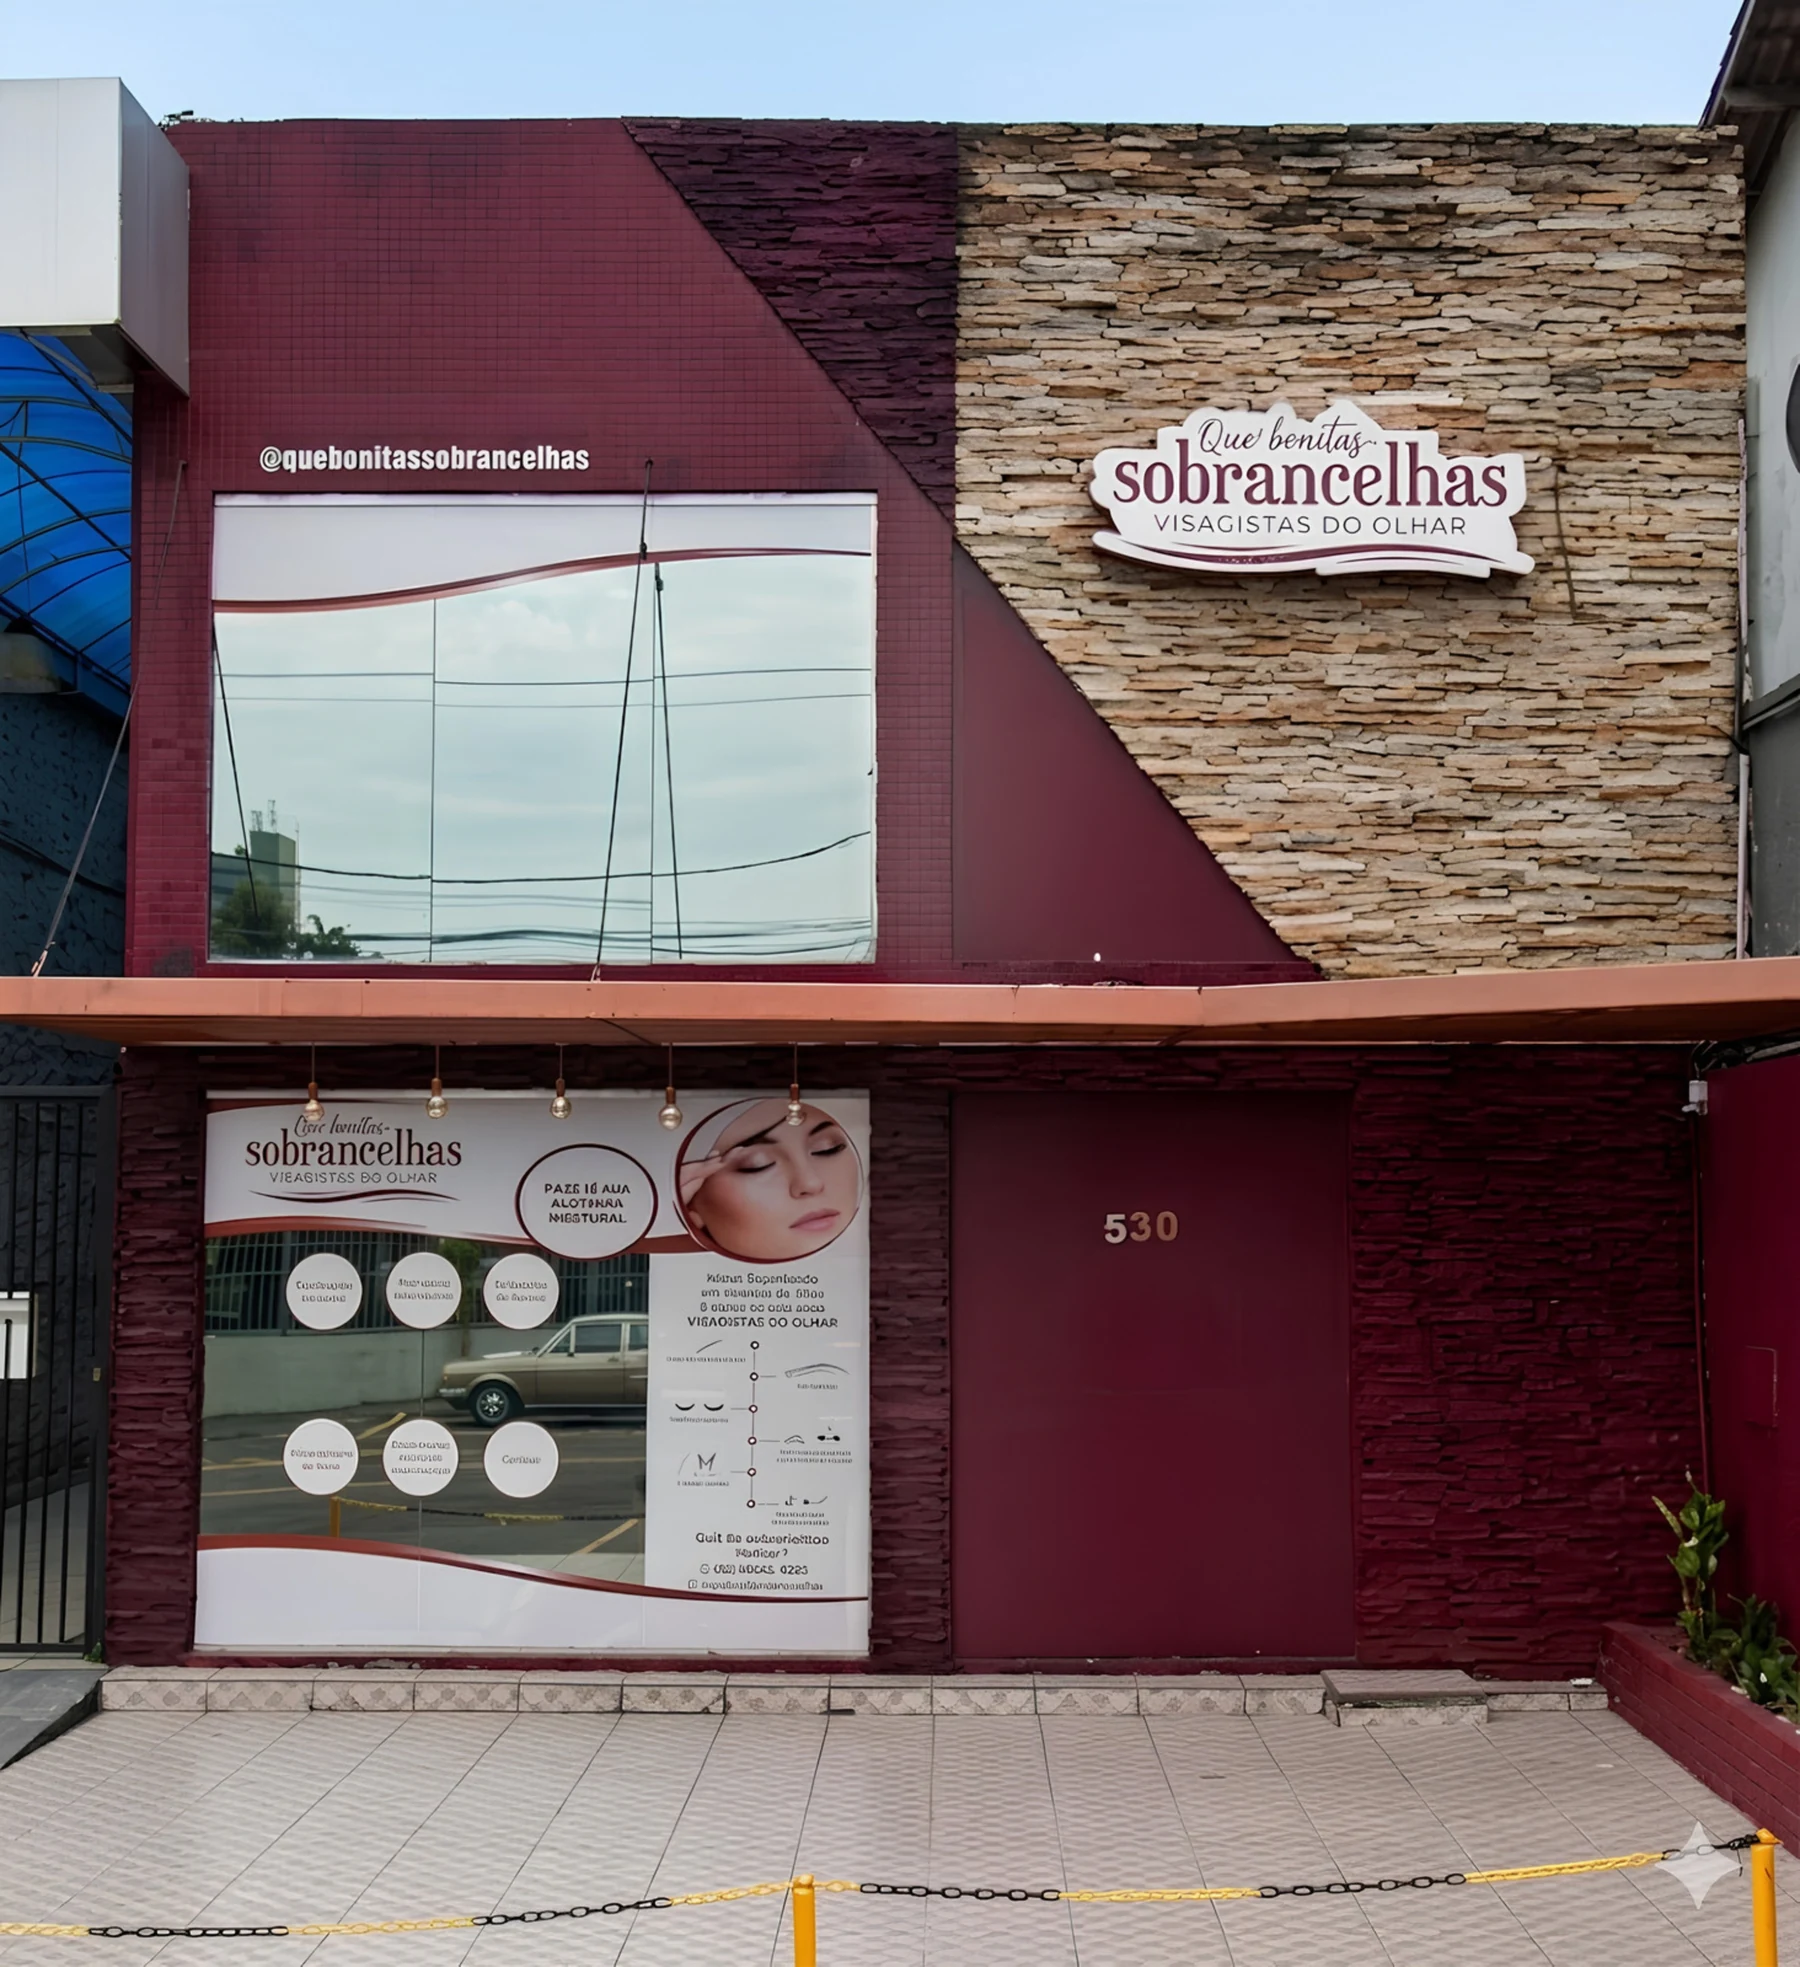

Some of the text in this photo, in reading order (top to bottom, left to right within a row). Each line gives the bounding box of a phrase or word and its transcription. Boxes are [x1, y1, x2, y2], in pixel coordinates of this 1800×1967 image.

[259, 445, 590, 474] @quebonitassobrancelhas
[1112, 438, 1508, 508] sobrancelhas
[1154, 513, 1467, 536] VISAGISTAS DO OLHAR
[245, 1128, 462, 1167] sobrancelhas
[1103, 1210, 1179, 1244] 530
